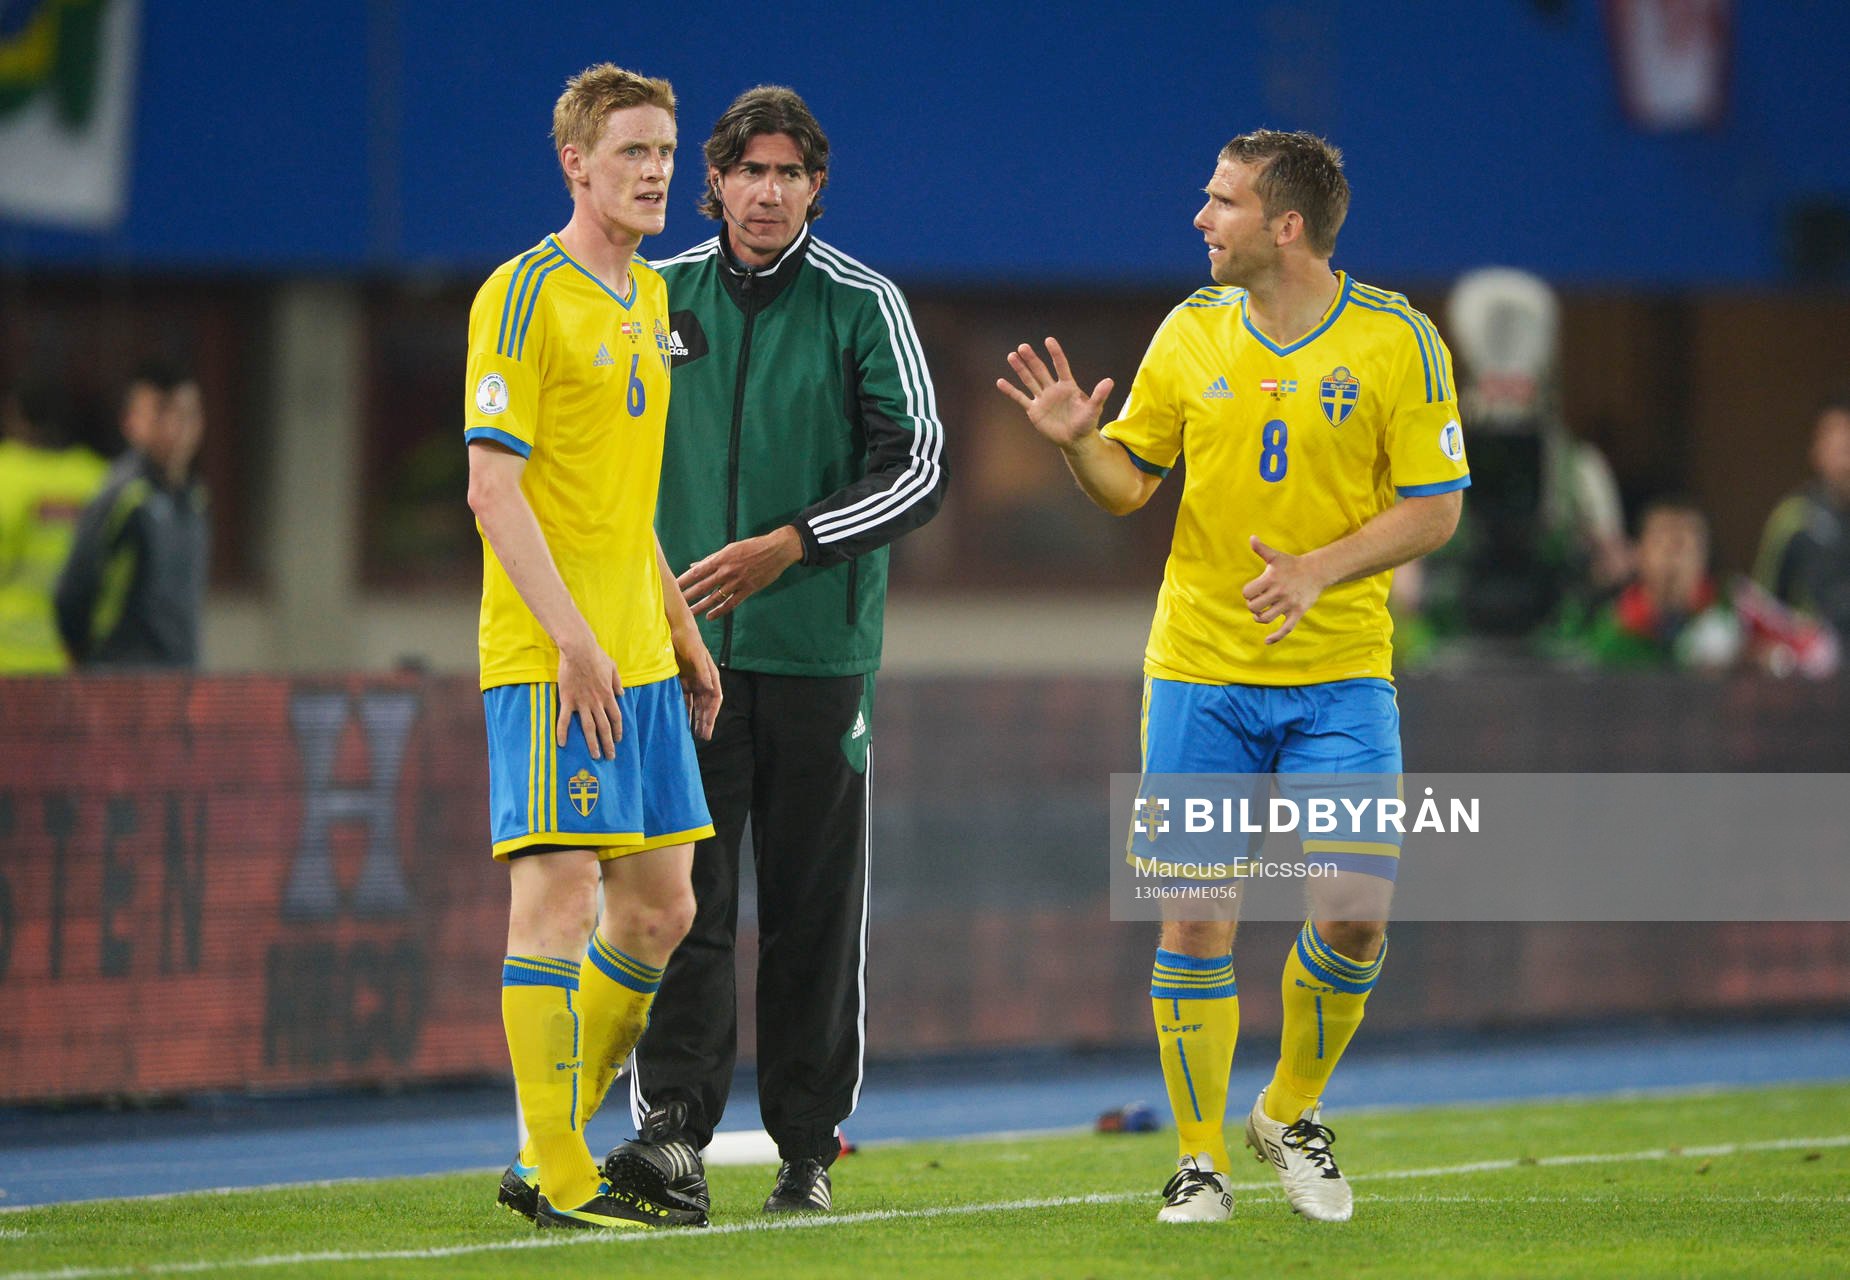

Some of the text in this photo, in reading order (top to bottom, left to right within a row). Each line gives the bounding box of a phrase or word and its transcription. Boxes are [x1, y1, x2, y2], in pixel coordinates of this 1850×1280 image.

[627, 354, 646, 418] 6
[1201, 391, 1235, 400] adidas
[1259, 419, 1288, 482] 8
